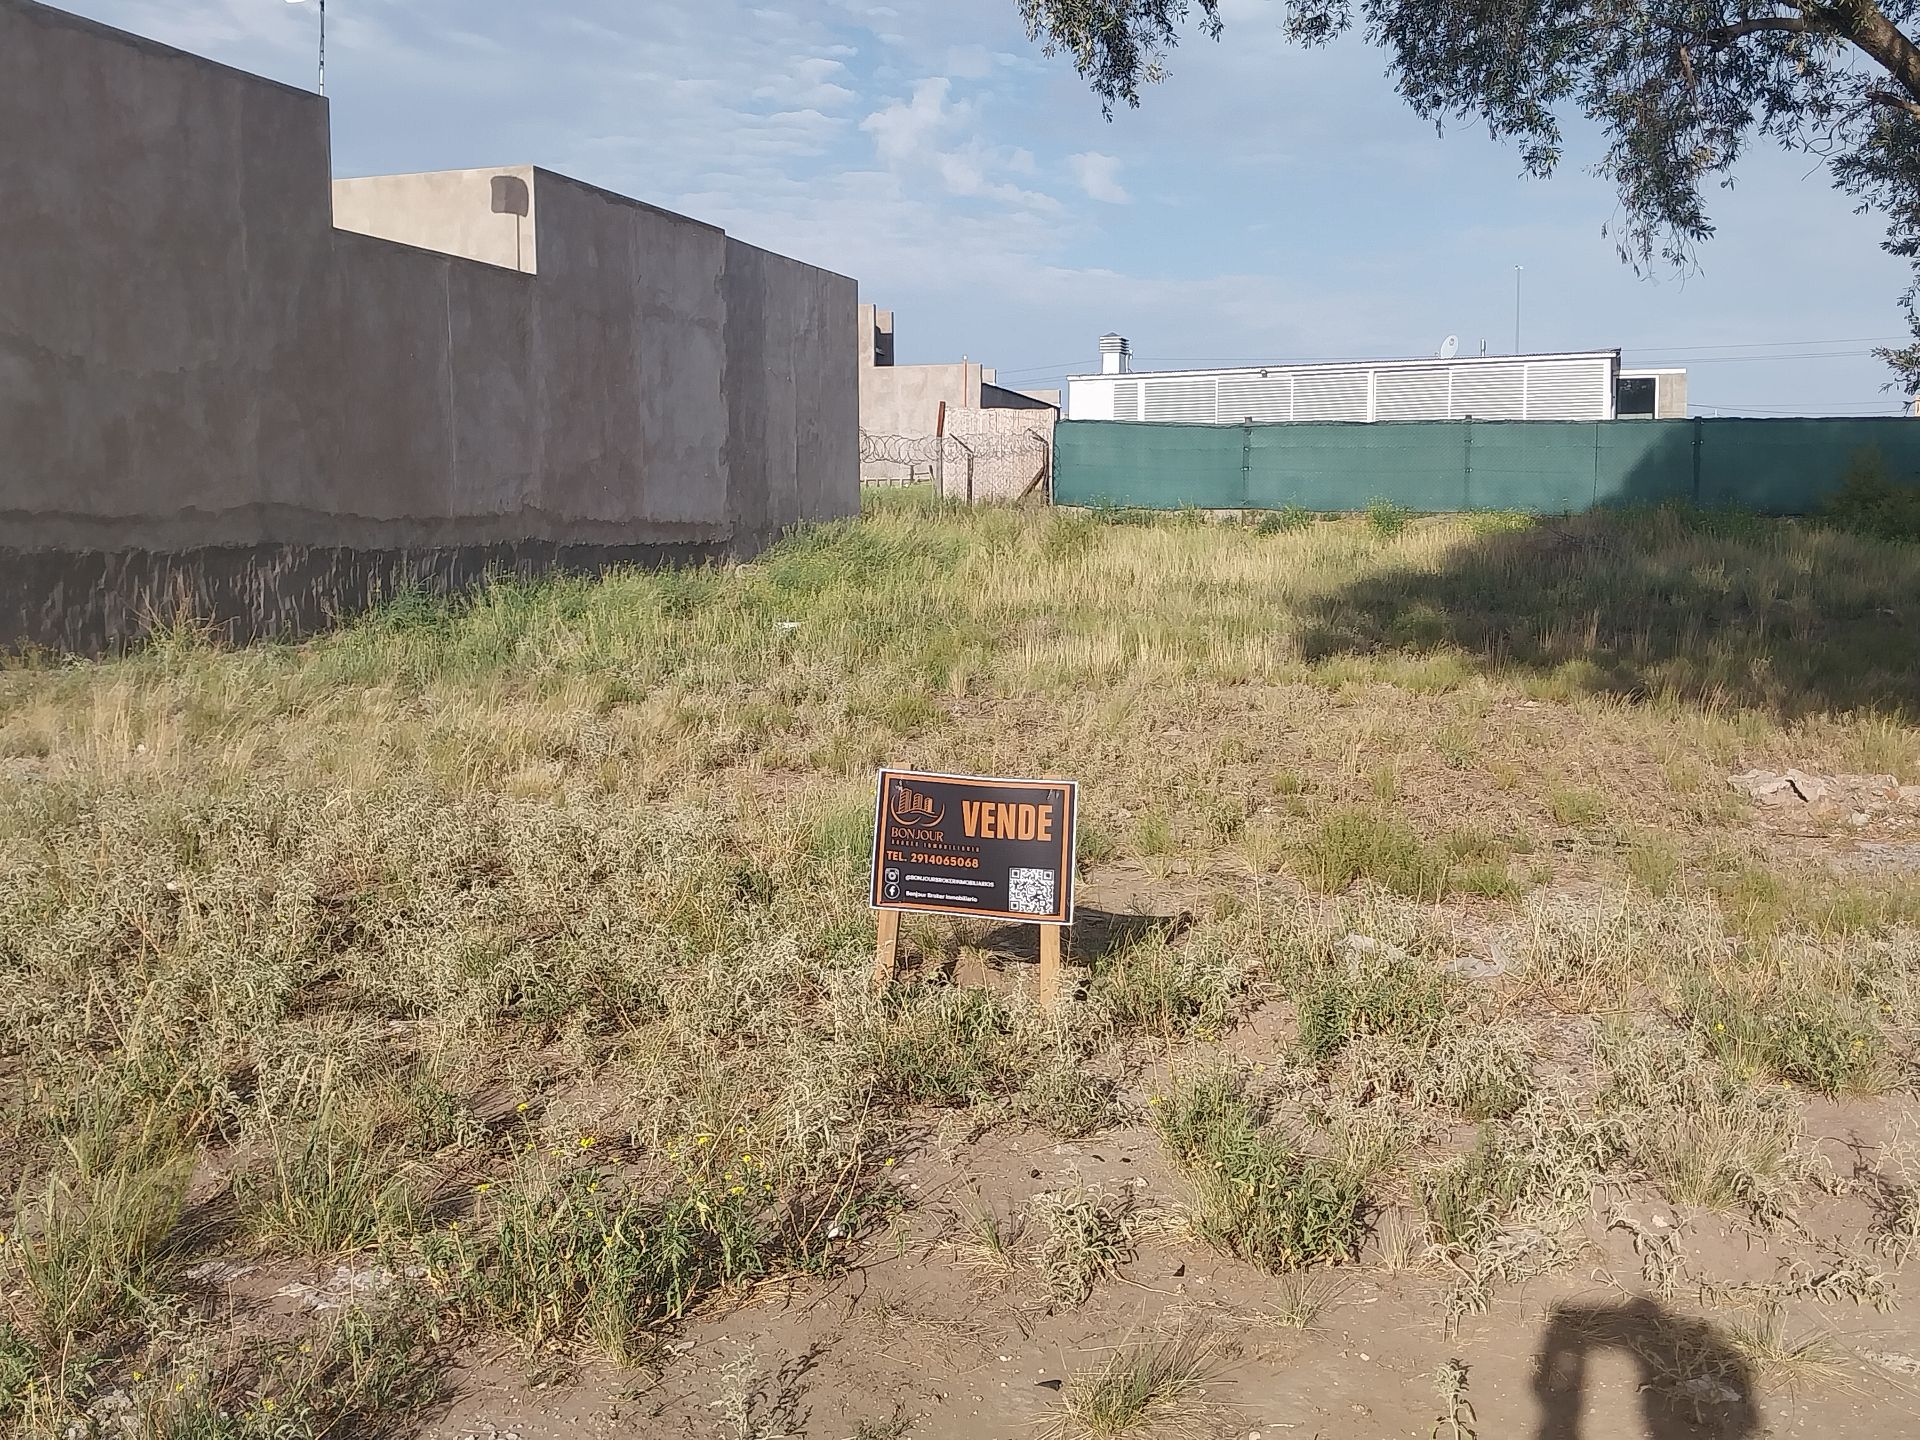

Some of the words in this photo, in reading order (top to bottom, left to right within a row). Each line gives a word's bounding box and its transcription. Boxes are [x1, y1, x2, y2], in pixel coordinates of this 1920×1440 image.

[961, 800, 1053, 841] VENDE
[891, 826, 944, 842] BONJOUR
[886, 850, 907, 862] TEL.
[910, 852, 979, 869] 2914065068
